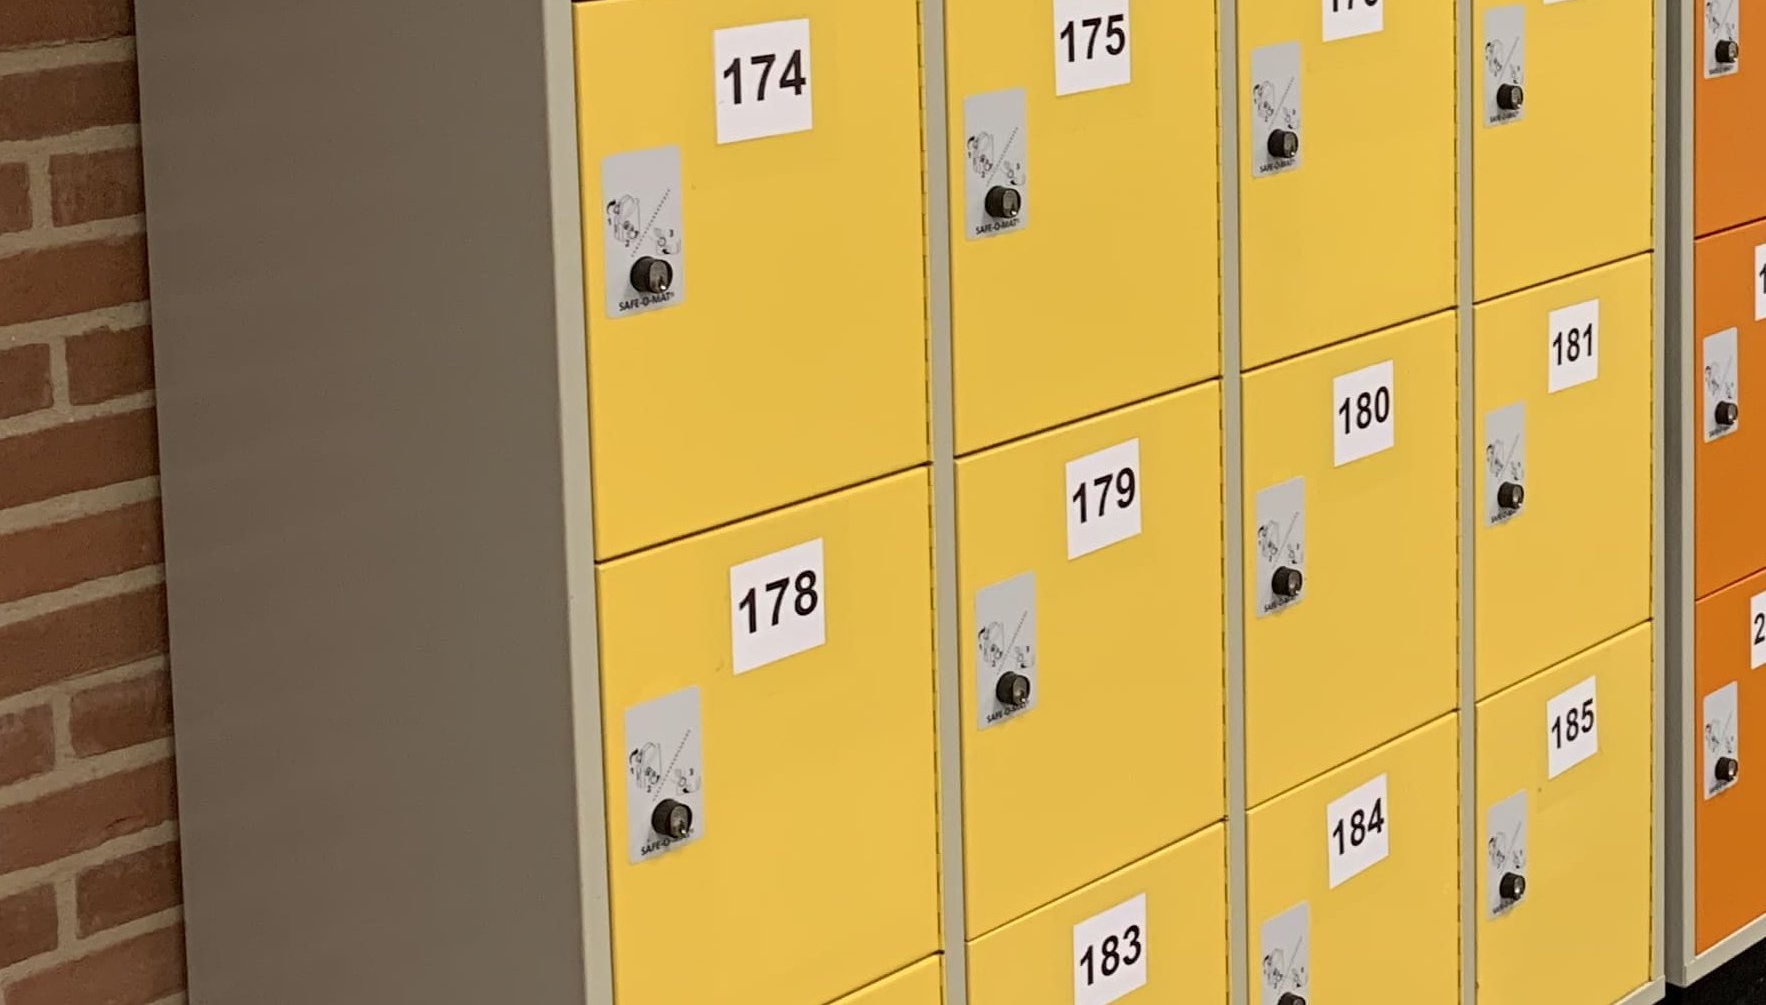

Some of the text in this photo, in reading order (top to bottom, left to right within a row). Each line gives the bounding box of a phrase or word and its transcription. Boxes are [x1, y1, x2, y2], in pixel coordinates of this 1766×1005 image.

[1060, 13, 1126, 63] 175
[723, 49, 807, 105] 174
[1552, 323, 1593, 366] 181
[1338, 386, 1390, 435] 180
[1072, 467, 1136, 524] 179
[739, 569, 818, 634] 178
[1551, 698, 1594, 749] 185
[1332, 797, 1385, 855] 184
[1079, 924, 1142, 986] 183
